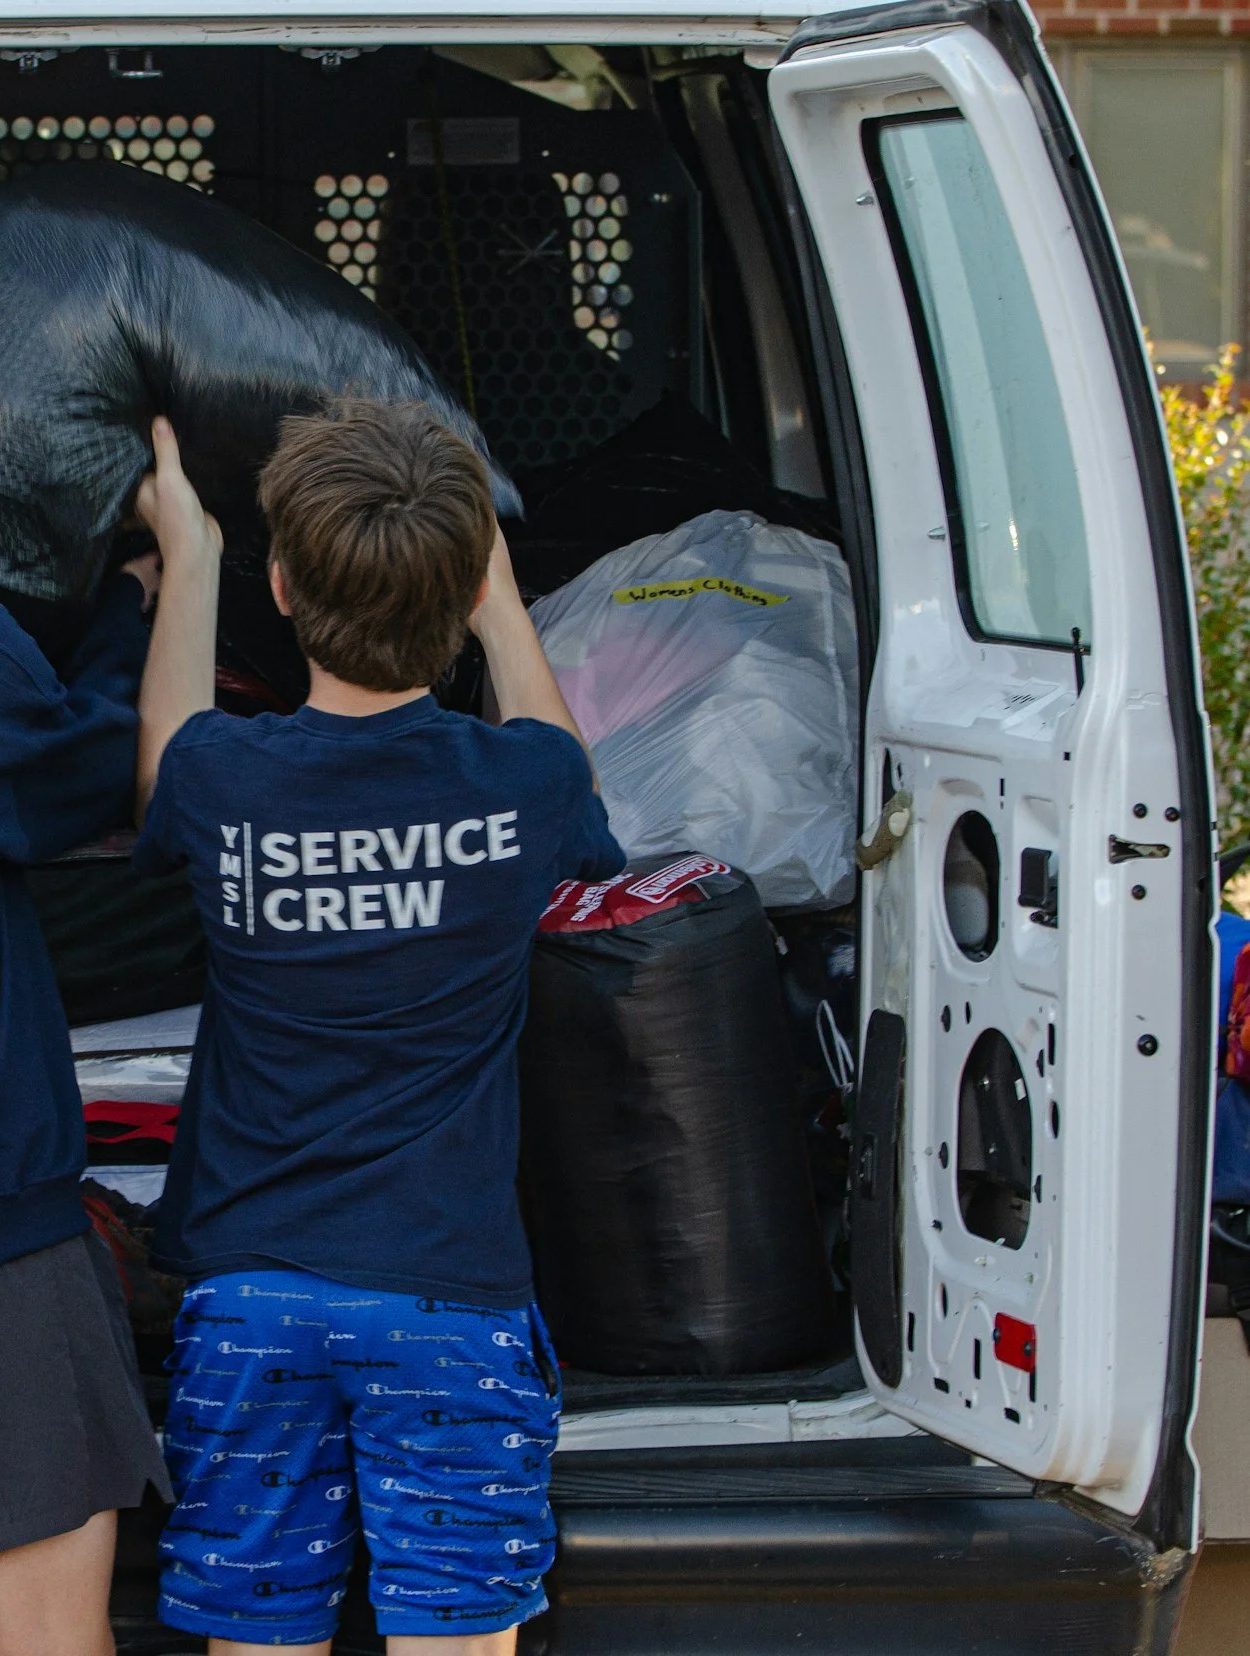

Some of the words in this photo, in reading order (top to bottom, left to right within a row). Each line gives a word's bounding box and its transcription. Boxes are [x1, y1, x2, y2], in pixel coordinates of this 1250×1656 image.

[630, 587, 696, 600] Womens
[703, 580, 767, 606] Clothing
[260, 810, 521, 878] SERVICE
[219, 824, 242, 928] YMSL
[262, 879, 445, 932] CREW
[237, 1285, 314, 1301] Champion
[386, 1330, 465, 1344] Champion
[217, 1341, 293, 1358] Champion
[366, 1383, 451, 1399] Champion
[210, 1451, 290, 1463] Champion
[380, 1477, 454, 1500] Champion
[202, 1553, 283, 1573] Champion
[382, 1584, 461, 1598] Champion
